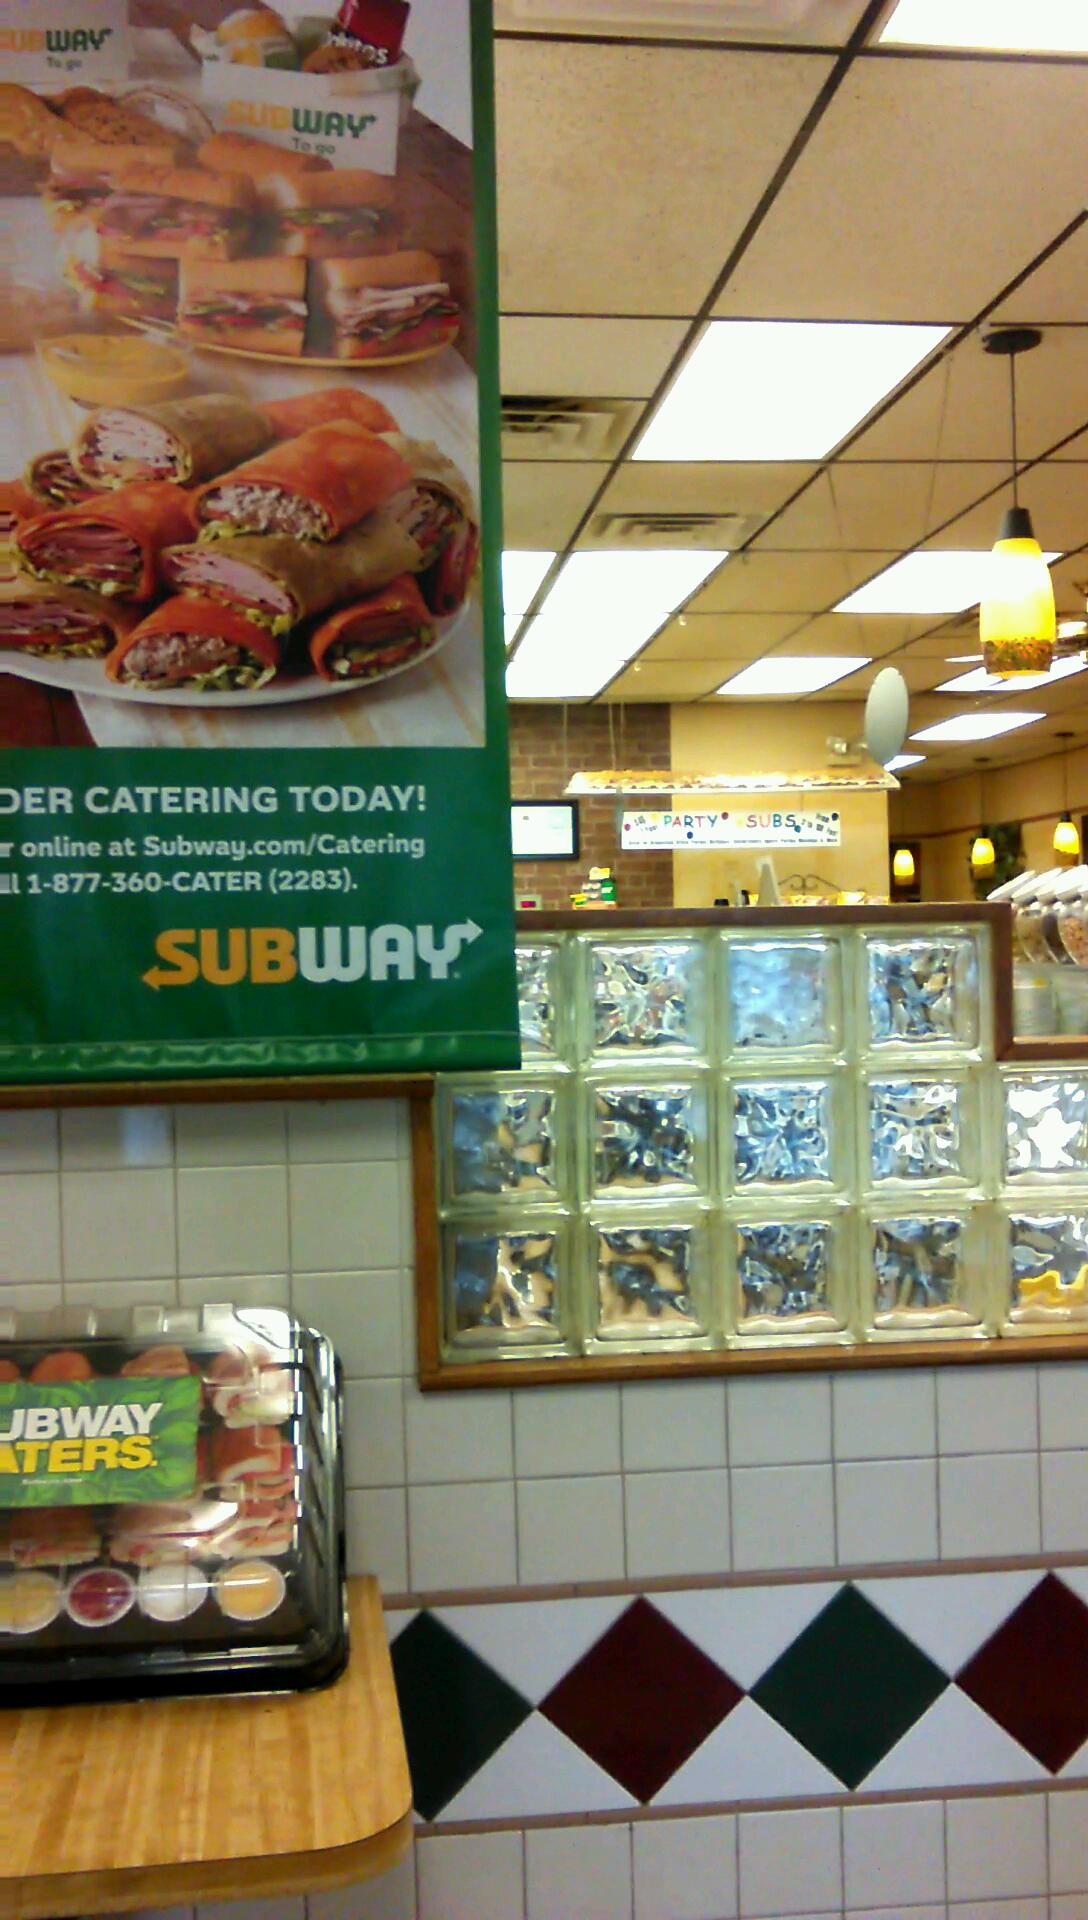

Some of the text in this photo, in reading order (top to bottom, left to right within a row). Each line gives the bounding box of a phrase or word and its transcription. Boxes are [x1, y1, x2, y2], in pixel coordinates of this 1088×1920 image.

[223, 99, 376, 138] SUBWAY
[292, 137, 336, 155] To go
[84, 786, 279, 813] CATERING
[288, 785, 427, 812] TODAY!
[663, 814, 718, 828] PARTY
[745, 813, 797, 828] SUBS
[21, 836, 102, 857] online
[108, 837, 137, 857] at
[143, 832, 426, 860] Subway.com/Catering
[27, 871, 263, 894] 1-877-360-CATER
[268, 867, 358, 894] (2283).
[141, 918, 484, 991] SUBWAY
